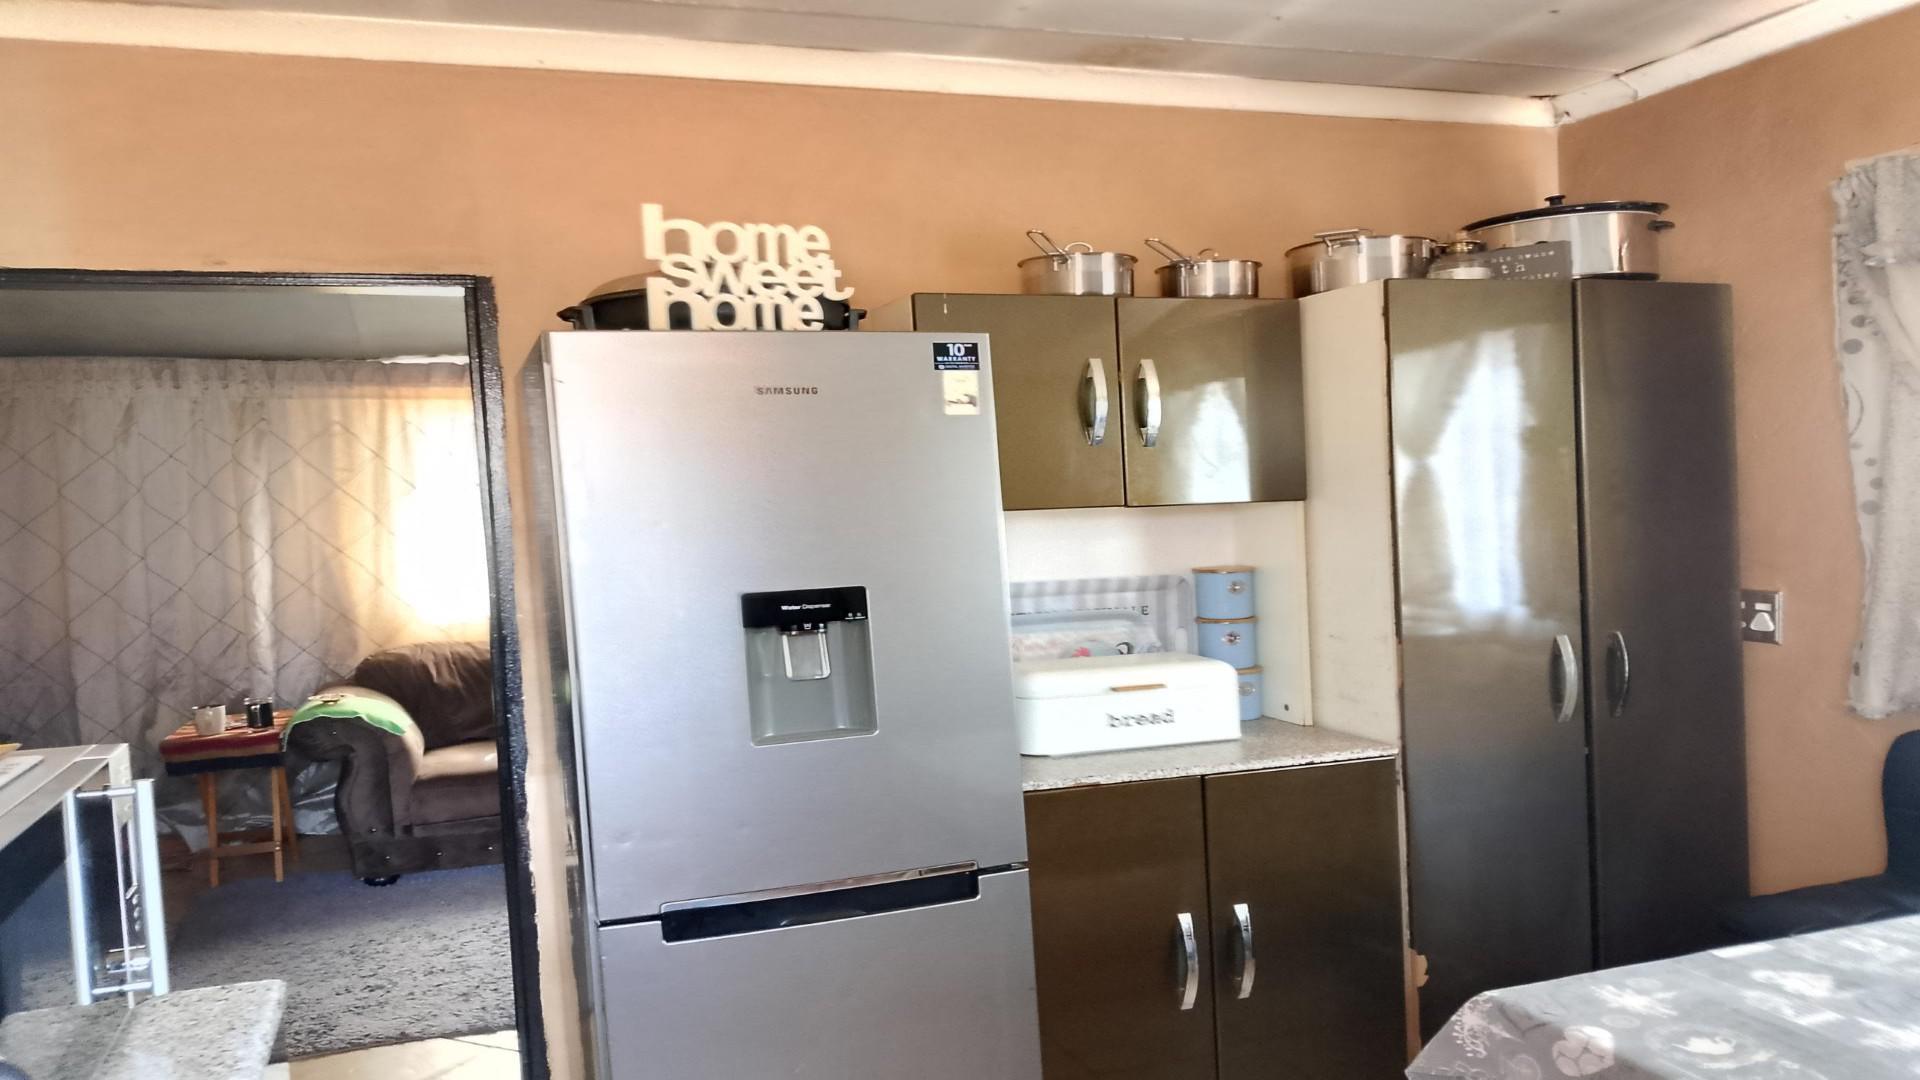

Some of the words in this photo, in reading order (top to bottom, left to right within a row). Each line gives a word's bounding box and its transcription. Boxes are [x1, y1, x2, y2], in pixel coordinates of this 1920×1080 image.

[641, 203, 832, 264] home
[660, 253, 855, 301] sweet
[647, 277, 825, 331] home
[946, 343, 965, 357] 10
[755, 386, 818, 396] SAMSUNG
[1105, 707, 1175, 728] bread
